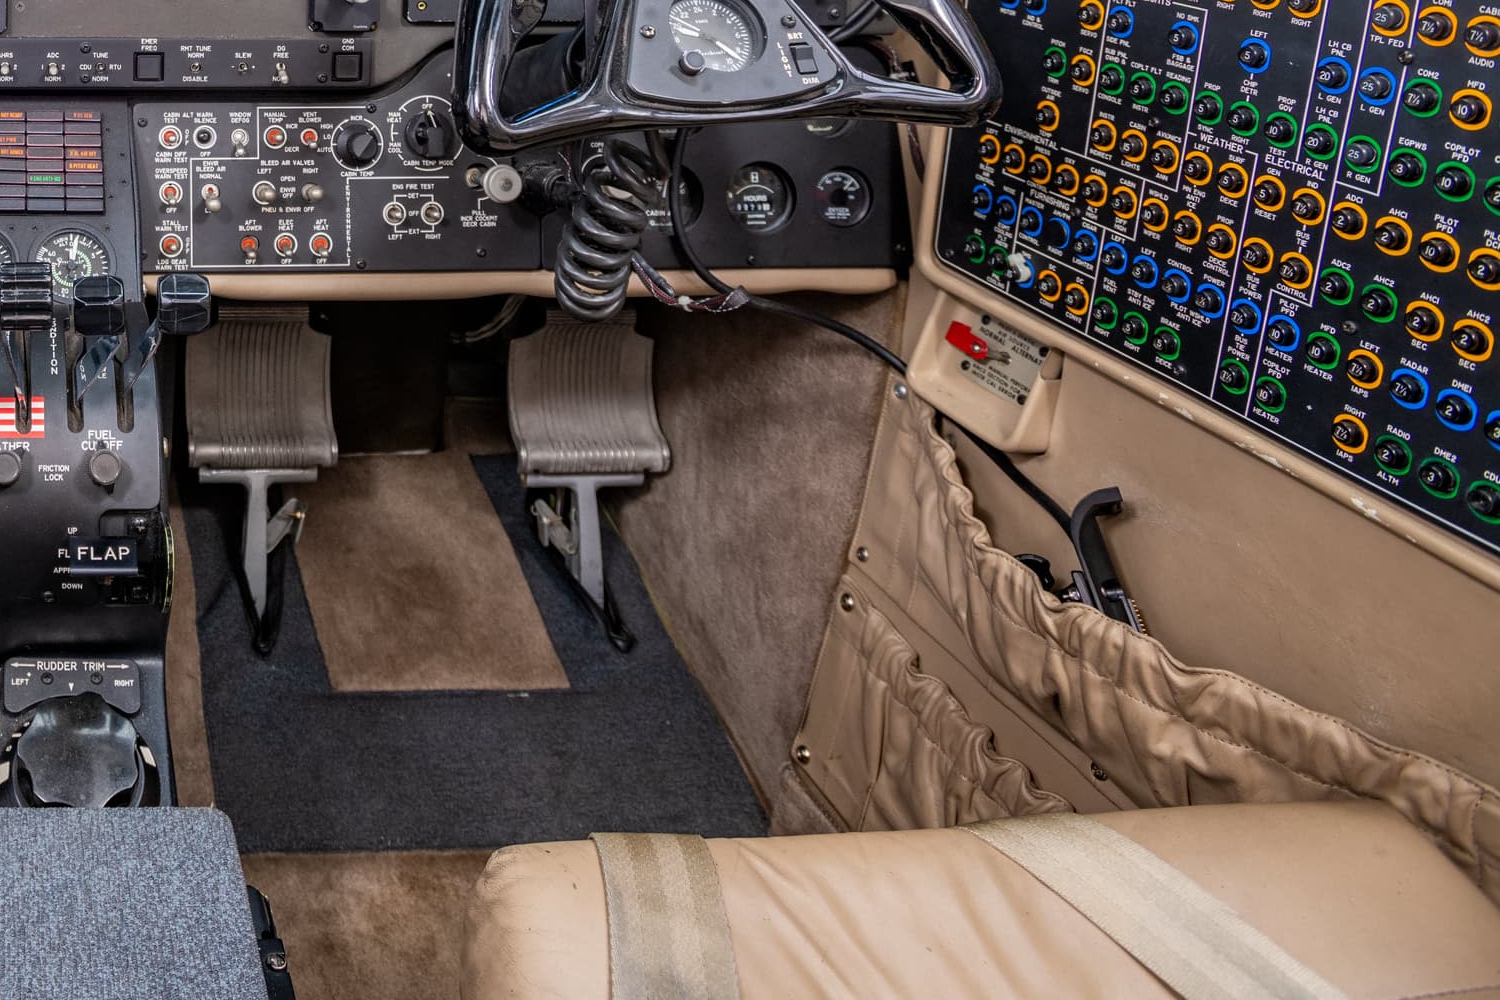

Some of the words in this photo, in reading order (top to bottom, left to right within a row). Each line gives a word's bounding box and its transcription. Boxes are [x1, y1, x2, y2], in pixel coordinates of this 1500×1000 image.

[1370, 34, 1384, 45] TPL
[1388, 38, 1404, 48] FED
[1468, 57, 1494, 68] AUDIO
[802, 77, 820, 85] DIM
[1467, 79, 1485, 90] MFD
[1398, 137, 1427, 150] EGPWS
[1444, 142, 1480, 157] COPILOT
[1264, 155, 1326, 181] ELECTRICAL
[1255, 209, 1277, 221] RESET
[1434, 214, 1459, 227] PILOT
[1276, 283, 1308, 300] CONTROL
[1304, 363, 1332, 382] HEATER
[1400, 357, 1429, 375] RADAR
[88, 430, 116, 439] FUEL
[1386, 424, 1411, 440] RADIO
[1377, 470, 1400, 486] ALTM
[77, 547, 130, 560] FLAP
[37, 661, 77, 672] RUDDER
[82, 661, 105, 672] TRIM
[11, 678, 29, 686] LEFT
